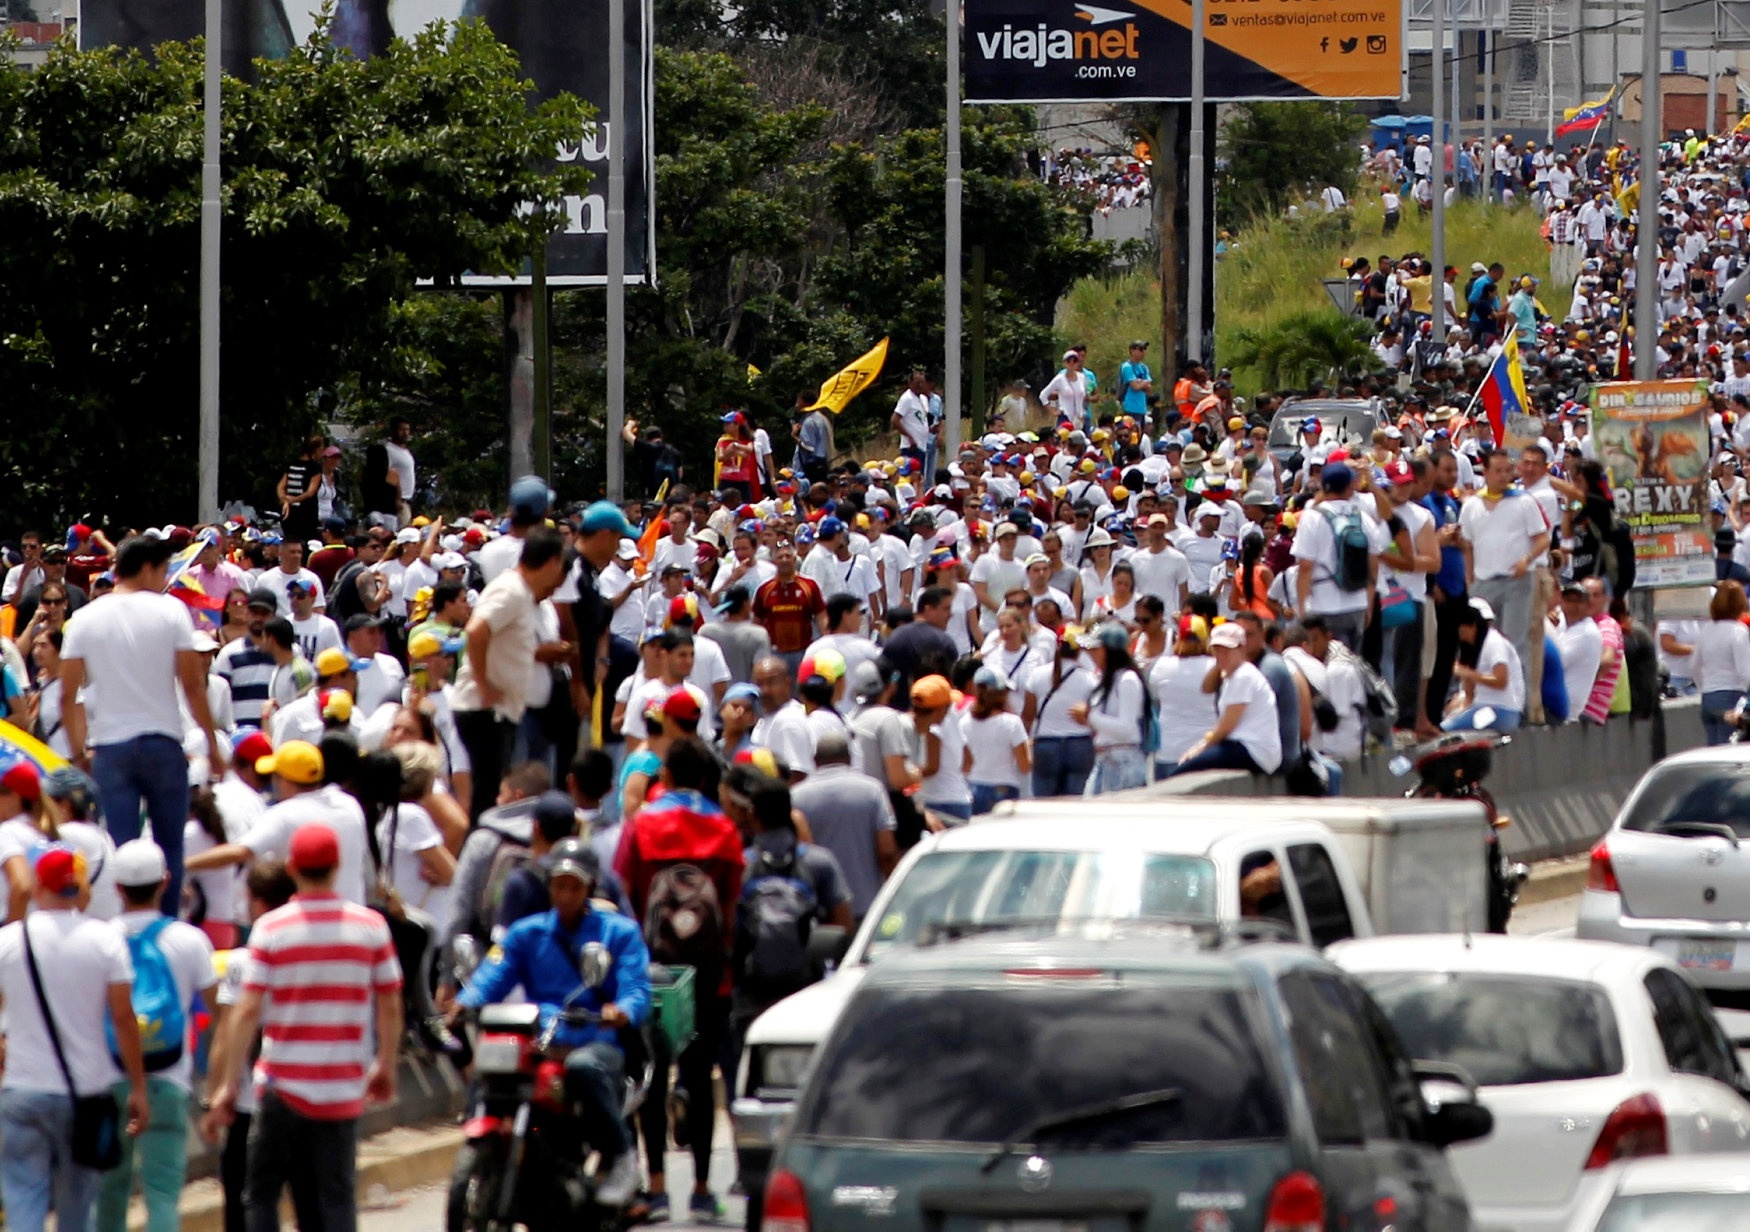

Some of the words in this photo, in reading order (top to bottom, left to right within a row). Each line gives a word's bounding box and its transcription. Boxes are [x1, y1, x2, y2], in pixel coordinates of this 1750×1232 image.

[1231, 11, 1386, 28] ventas@viajanet.com.ve
[976, 23, 1139, 67] viajanet
[1075, 65, 1137, 78] .com.ve
[1613, 484, 1693, 513] REXY
